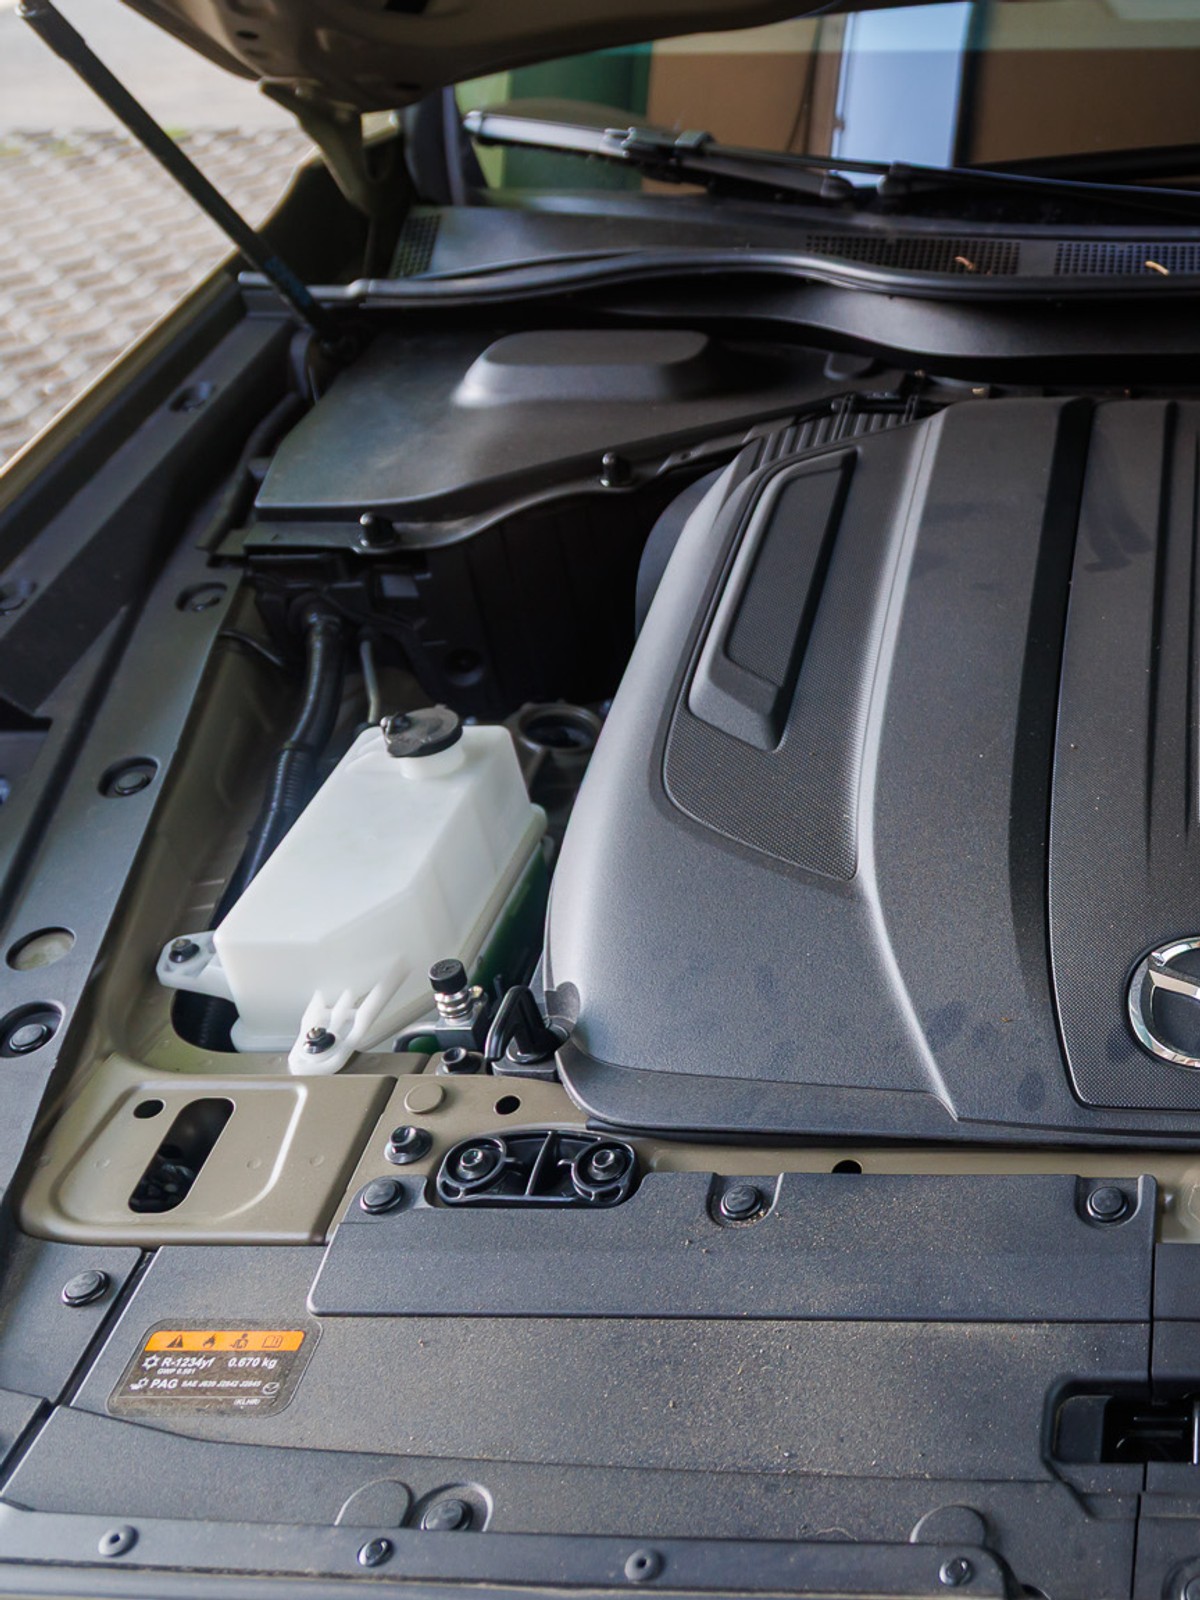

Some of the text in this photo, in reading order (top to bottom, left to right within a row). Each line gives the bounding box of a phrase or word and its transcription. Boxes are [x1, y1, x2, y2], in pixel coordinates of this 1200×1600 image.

[227, 1357, 261, 1367] 0.670
[261, 1357, 278, 1369] kg
[149, 1379, 179, 1389] PAG
